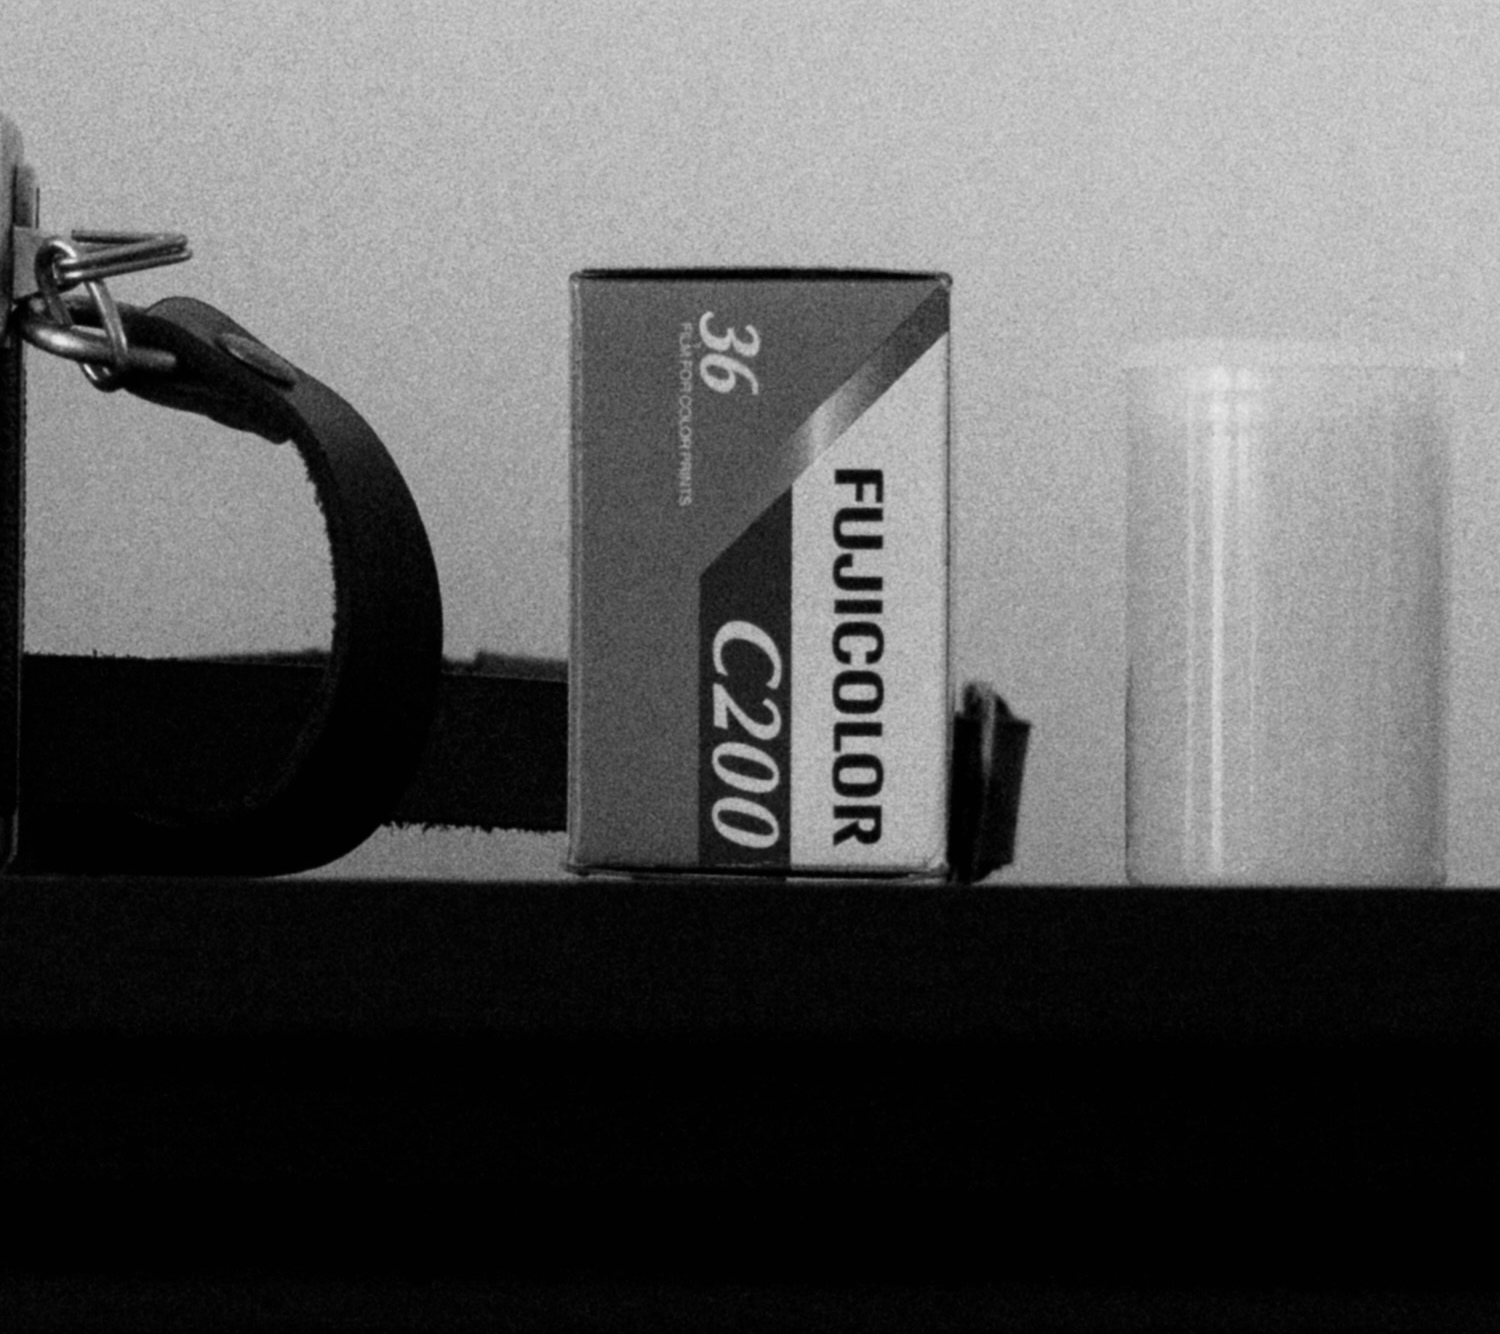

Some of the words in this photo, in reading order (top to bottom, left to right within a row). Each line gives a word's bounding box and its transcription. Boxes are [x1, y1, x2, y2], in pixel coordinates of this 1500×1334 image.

[679, 360, 694, 393] FOR
[699, 310, 761, 396] 36
[679, 395, 694, 449] COLOR
[831, 468, 885, 848] FUJICOLOR
[710, 619, 782, 850] C200
